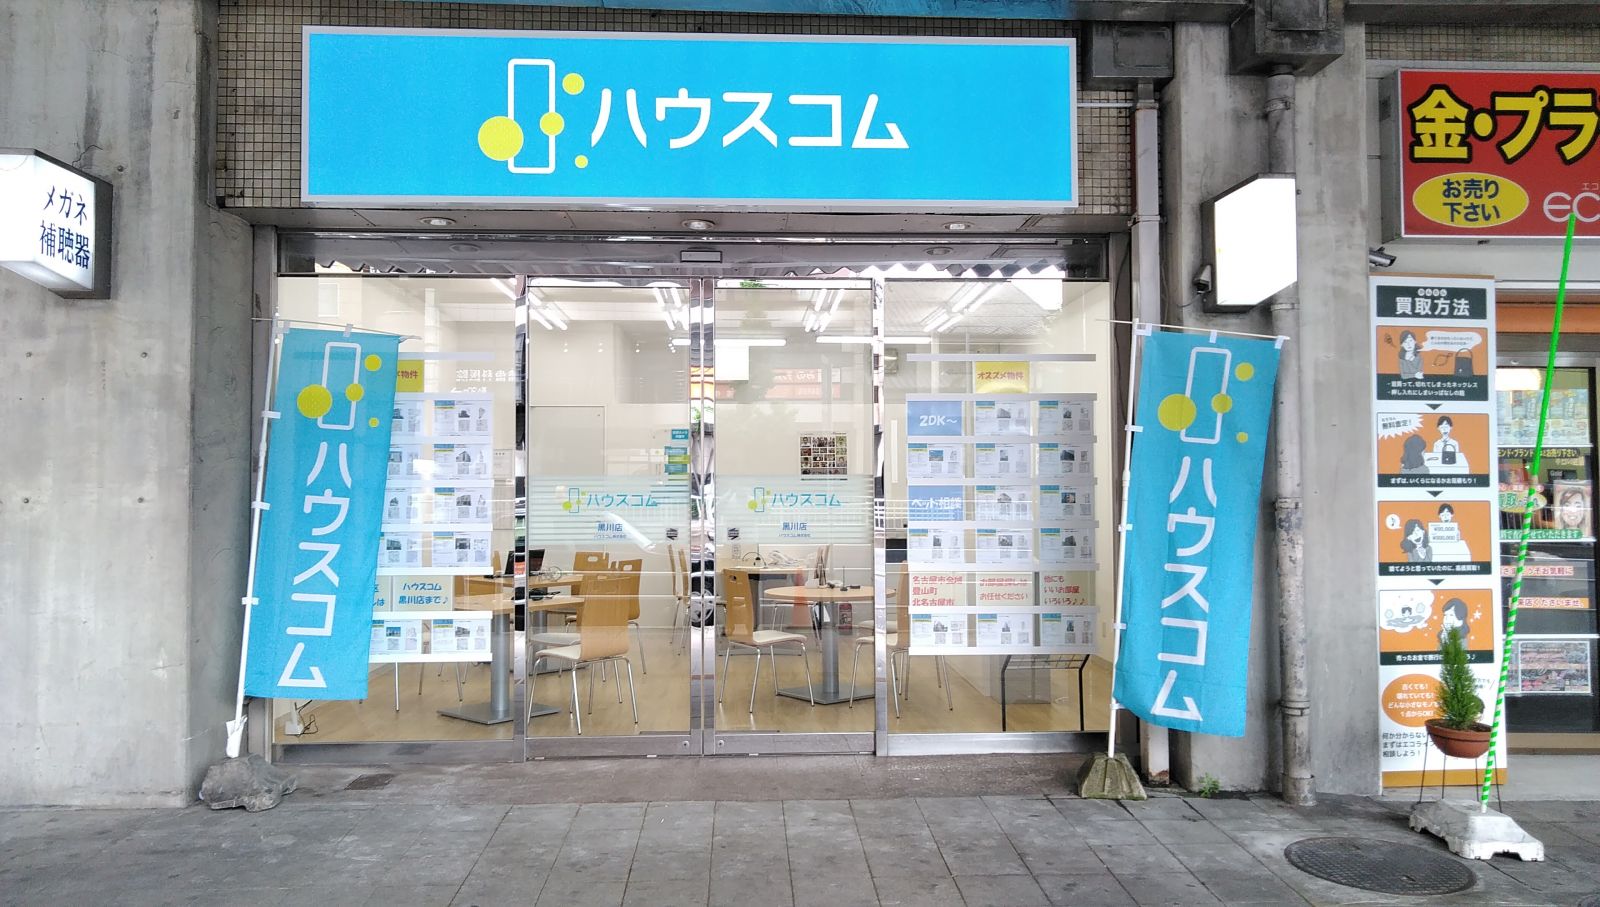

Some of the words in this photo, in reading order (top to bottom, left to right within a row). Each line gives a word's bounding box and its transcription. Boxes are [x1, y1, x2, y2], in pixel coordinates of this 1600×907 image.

[591, 88, 909, 149] ハウスコム
[1407, 84, 1600, 165] 金・プラ
[1442, 178, 1500, 200] お売り
[44, 185, 88, 226] メガネ
[1442, 202, 1500, 222] 下さい
[39, 219, 90, 270] 補聴器
[1395, 297, 1470, 316] 買取方法
[977, 371, 1024, 380] オススメ物件
[587, 494, 658, 507] ハウスコム
[772, 493, 841, 507] ハウスコム
[597, 523, 623, 532] 黒川店
[782, 521, 808, 531] 黒川店
[277, 441, 352, 688] ハウスコム
[912, 575, 963, 584] 名古屋市全域
[1043, 575, 1065, 583] 他にも
[403, 582, 442, 591] ハウスコム
[912, 586, 938, 596] 豊山町
[1043, 585, 1080, 594] いいお部屋
[1150, 456, 1217, 721] ハウスコム
[912, 597, 955, 606] 北名古屋市
[980, 592, 1028, 601] お任せください
